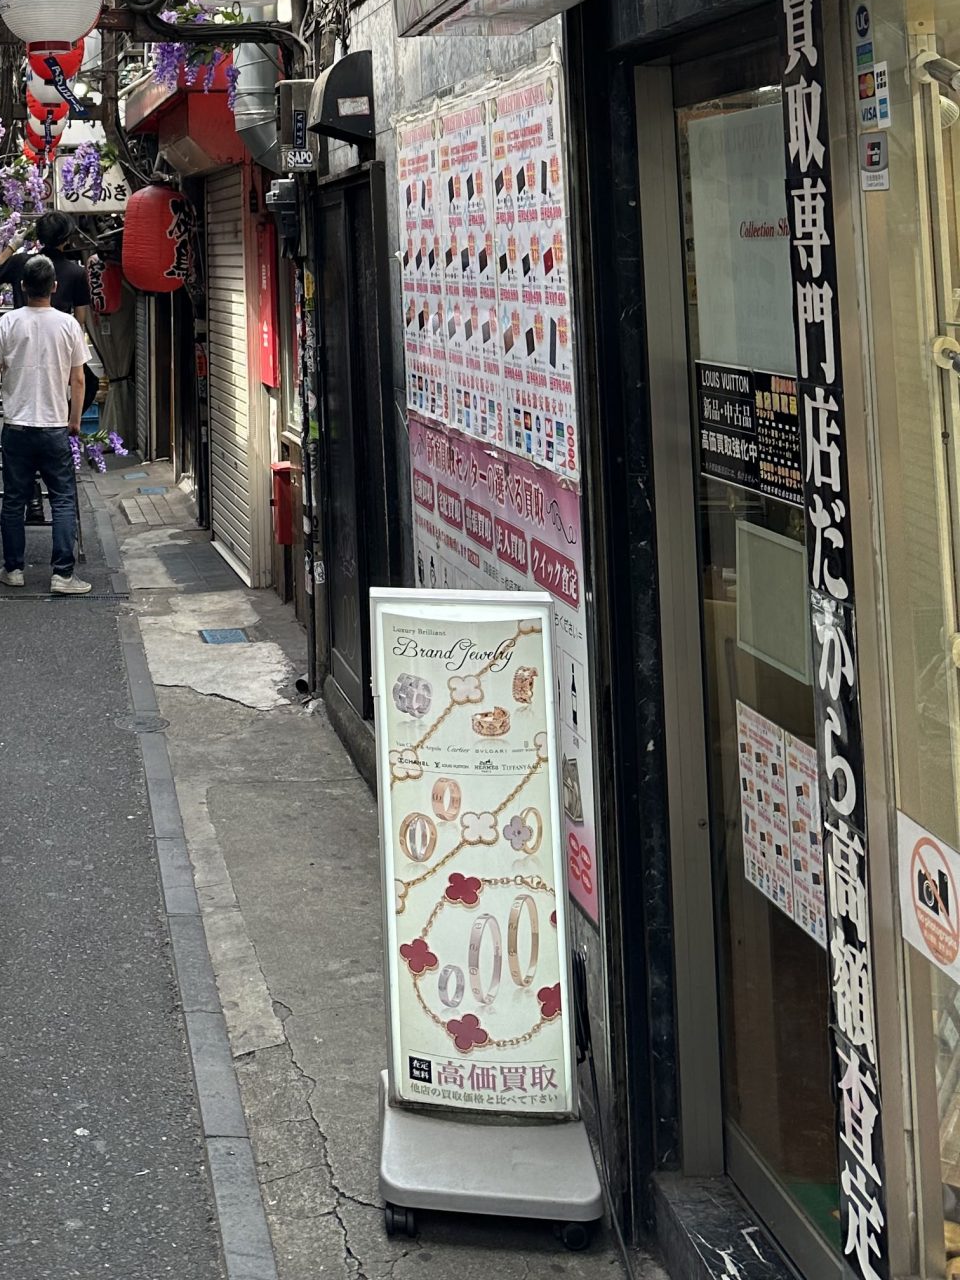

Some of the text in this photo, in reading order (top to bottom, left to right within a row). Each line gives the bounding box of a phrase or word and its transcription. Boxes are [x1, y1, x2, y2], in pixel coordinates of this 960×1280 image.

[856, 13, 869, 31] UC
[861, 105, 878, 122] VISA
[296, 114, 304, 145] VETA
[739, 220, 775, 238] Collection
[701, 370, 720, 389] LOUIS
[721, 372, 750, 394] VUITTON
[703, 396, 752, 429] 新品・中古品
[700, 429, 758, 464] 高価買取強化中
[496, 523, 527, 564] 法人買取
[532, 545, 578, 601] クイック査定
[392, 625, 447, 637] Luxury Brilliant
[392, 636, 517, 673] Brand Jewelry
[446, 743, 471, 754] Cartier
[412, 1058, 430, 1070] 査定
[412, 1068, 430, 1080] 無料
[435, 1060, 559, 1093] 高価買取
[410, 1082, 559, 1106] 他店の買取価格と比べて下さい
